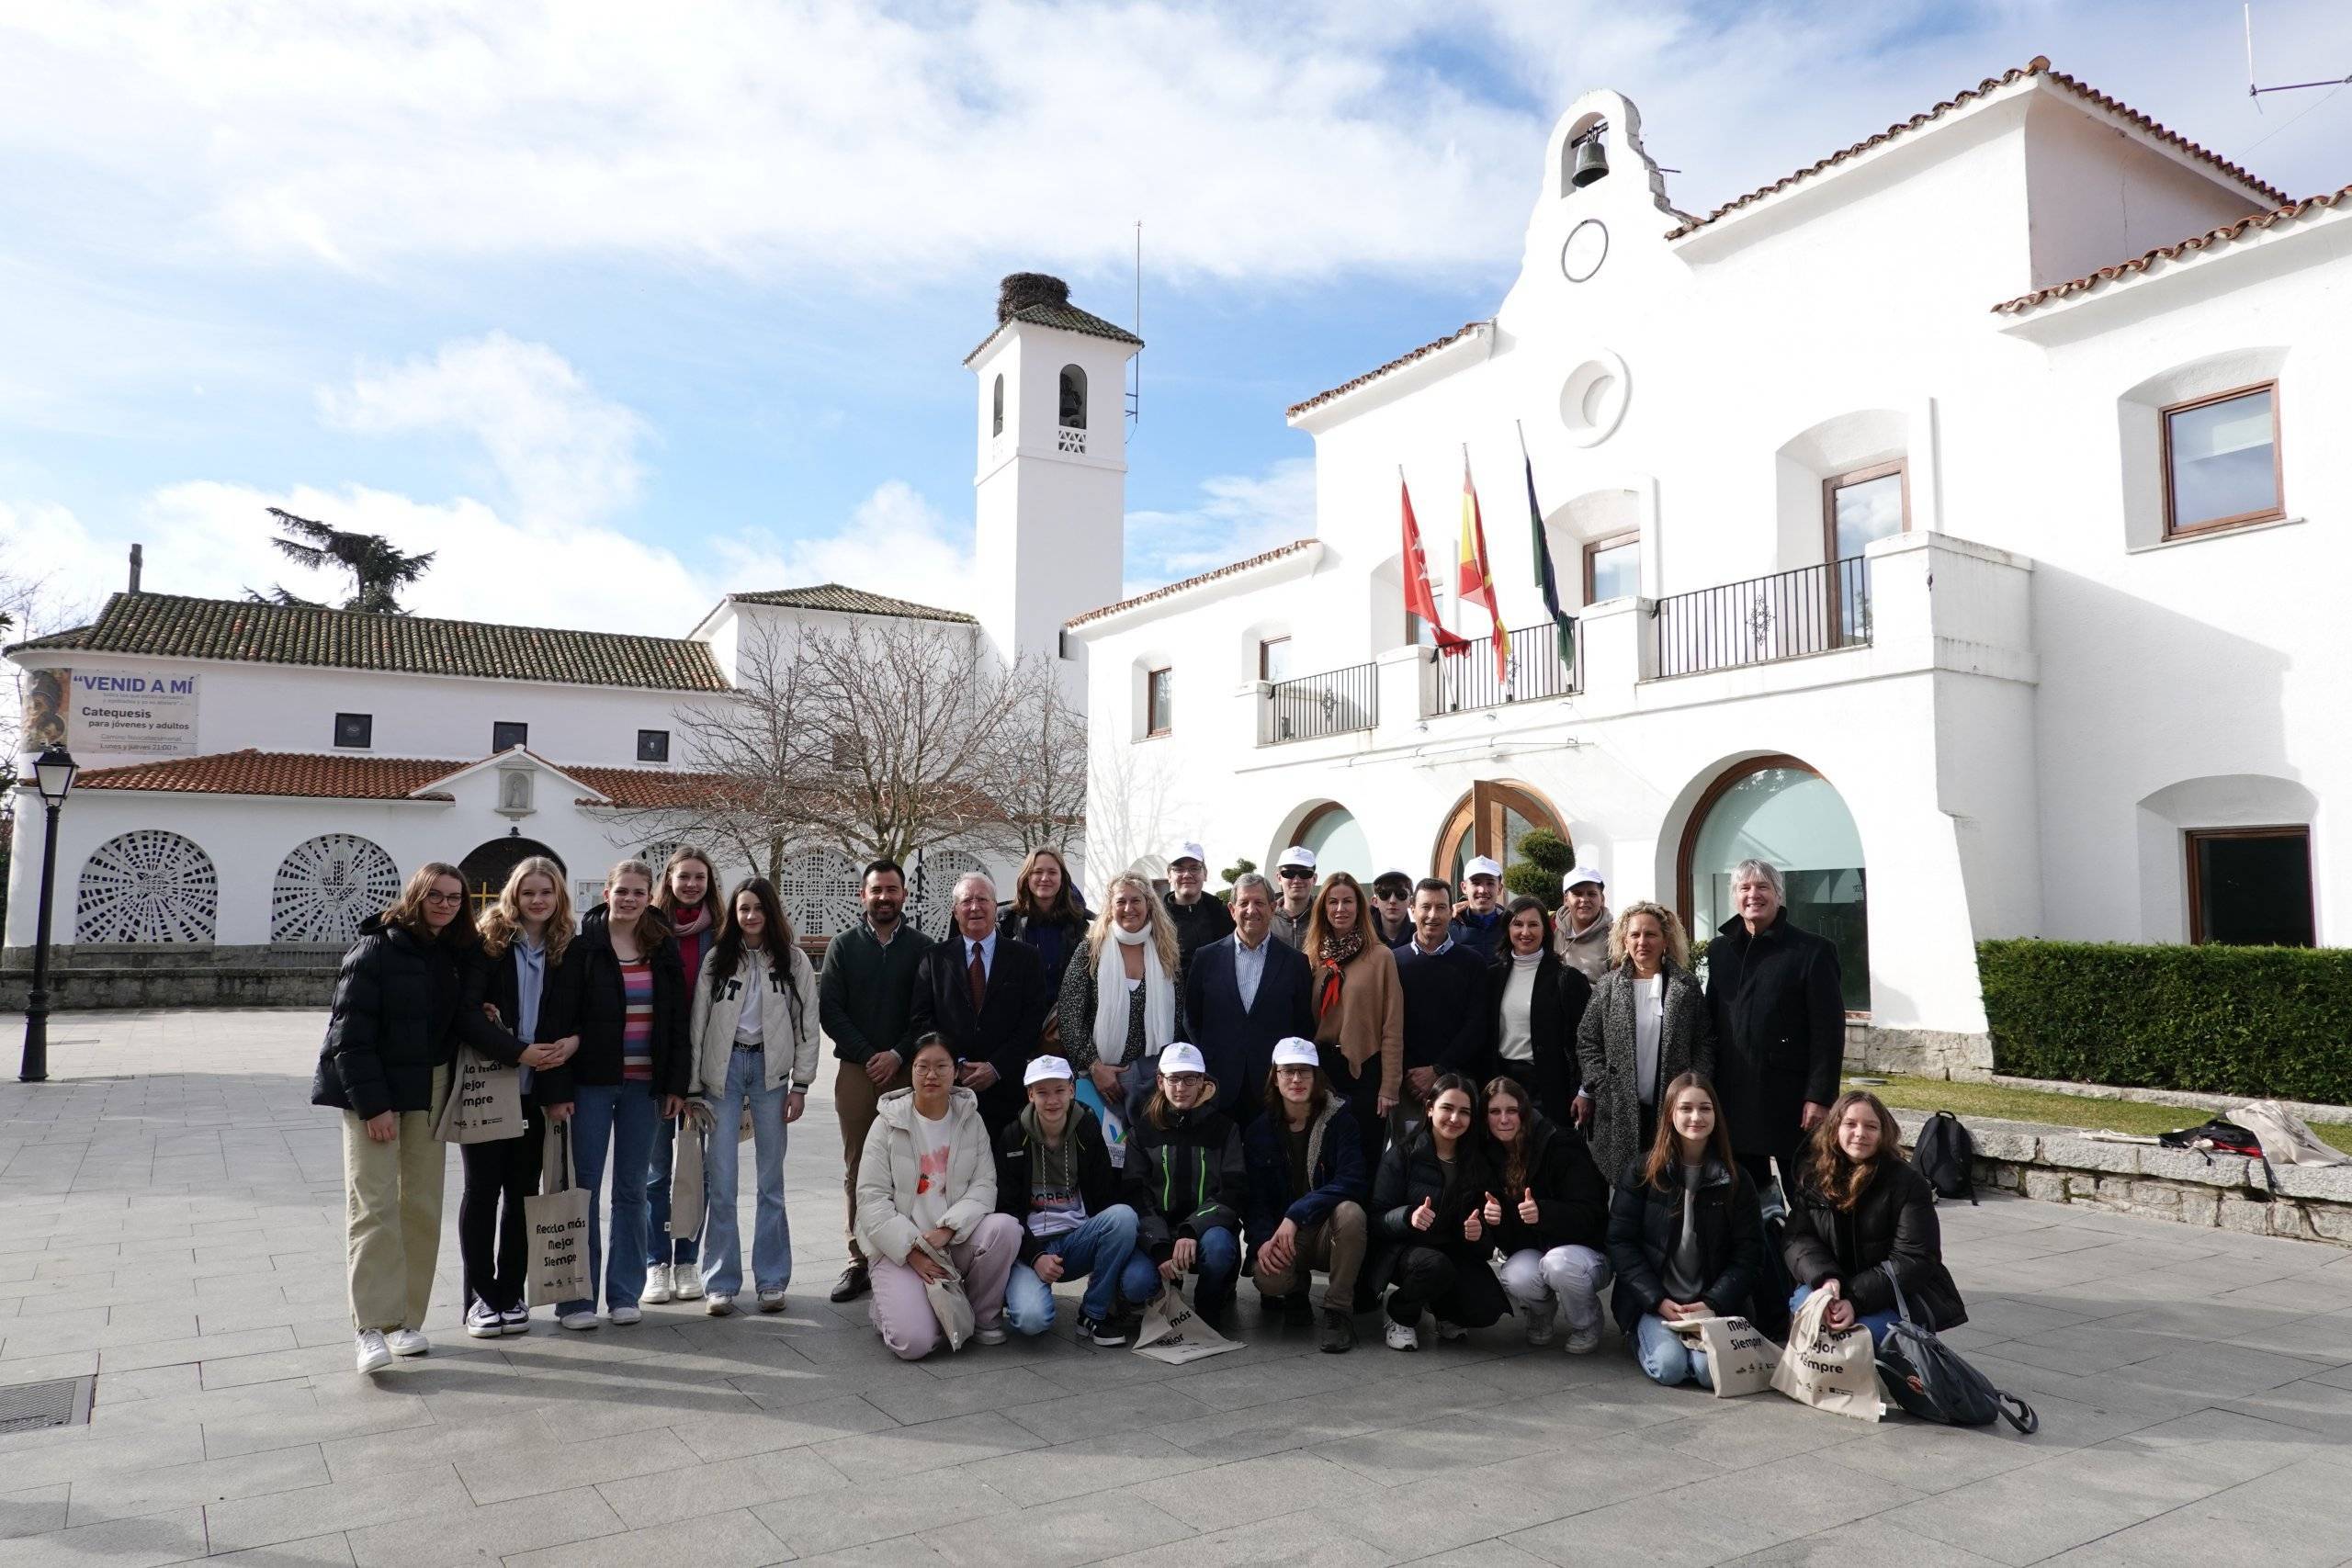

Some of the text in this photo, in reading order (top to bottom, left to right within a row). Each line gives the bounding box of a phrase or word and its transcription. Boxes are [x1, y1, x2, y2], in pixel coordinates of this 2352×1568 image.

[151, 679, 165, 694] A
[170, 676, 194, 694] MÍ
[82, 706, 152, 718] Catequesis
[88, 720, 189, 730] para jóvenes y adultos
[462, 1079, 486, 1091] ejor
[567, 1217, 586, 1229] más
[1170, 1310, 1192, 1328] más
